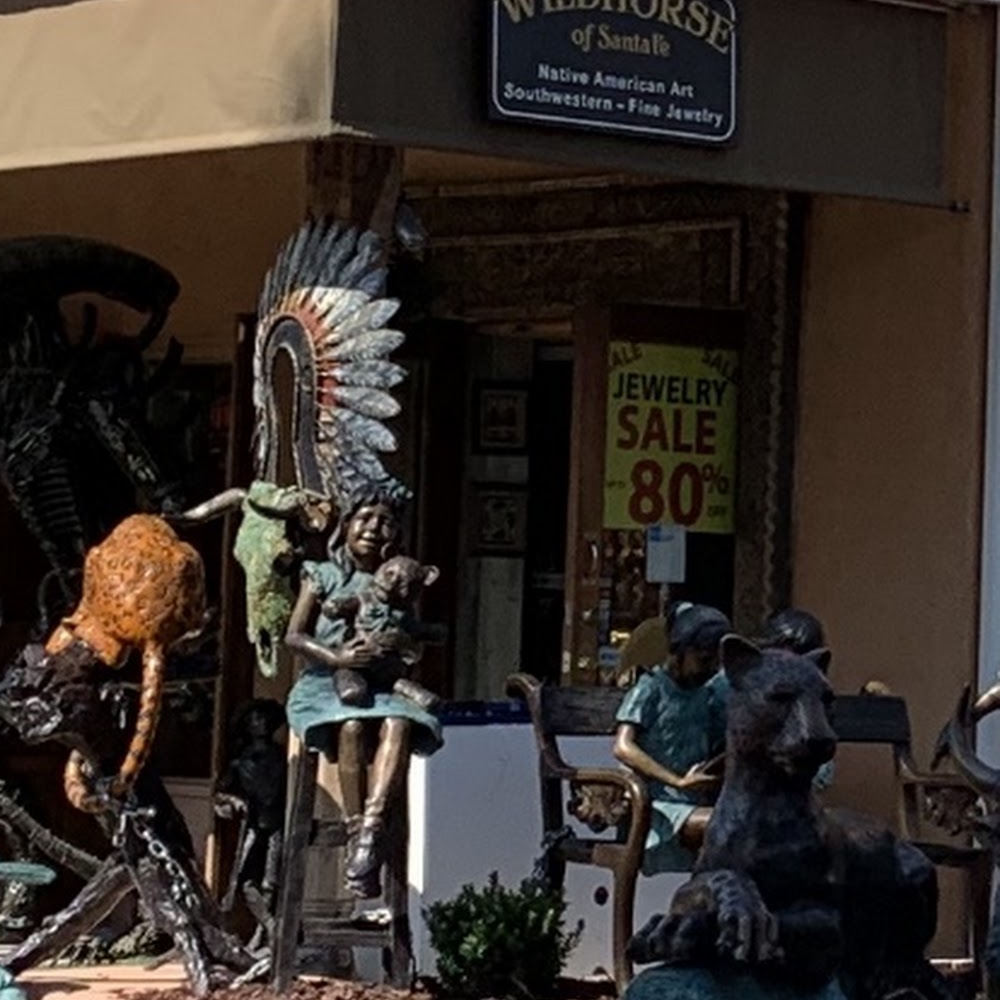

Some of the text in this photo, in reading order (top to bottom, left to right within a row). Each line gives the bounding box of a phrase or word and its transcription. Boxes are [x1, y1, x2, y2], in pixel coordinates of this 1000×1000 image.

[571, 23, 595, 53] of
[598, 23, 650, 55] Santa
[538, 63, 695, 98] Native American Art
[503, 81, 613, 111] Southwestern
[627, 98, 661, 118] Fine
[666, 103, 724, 128] Jewelry
[611, 342, 643, 366] ALE
[612, 371, 729, 407] JEWELRY
[616, 403, 718, 456] SALE
